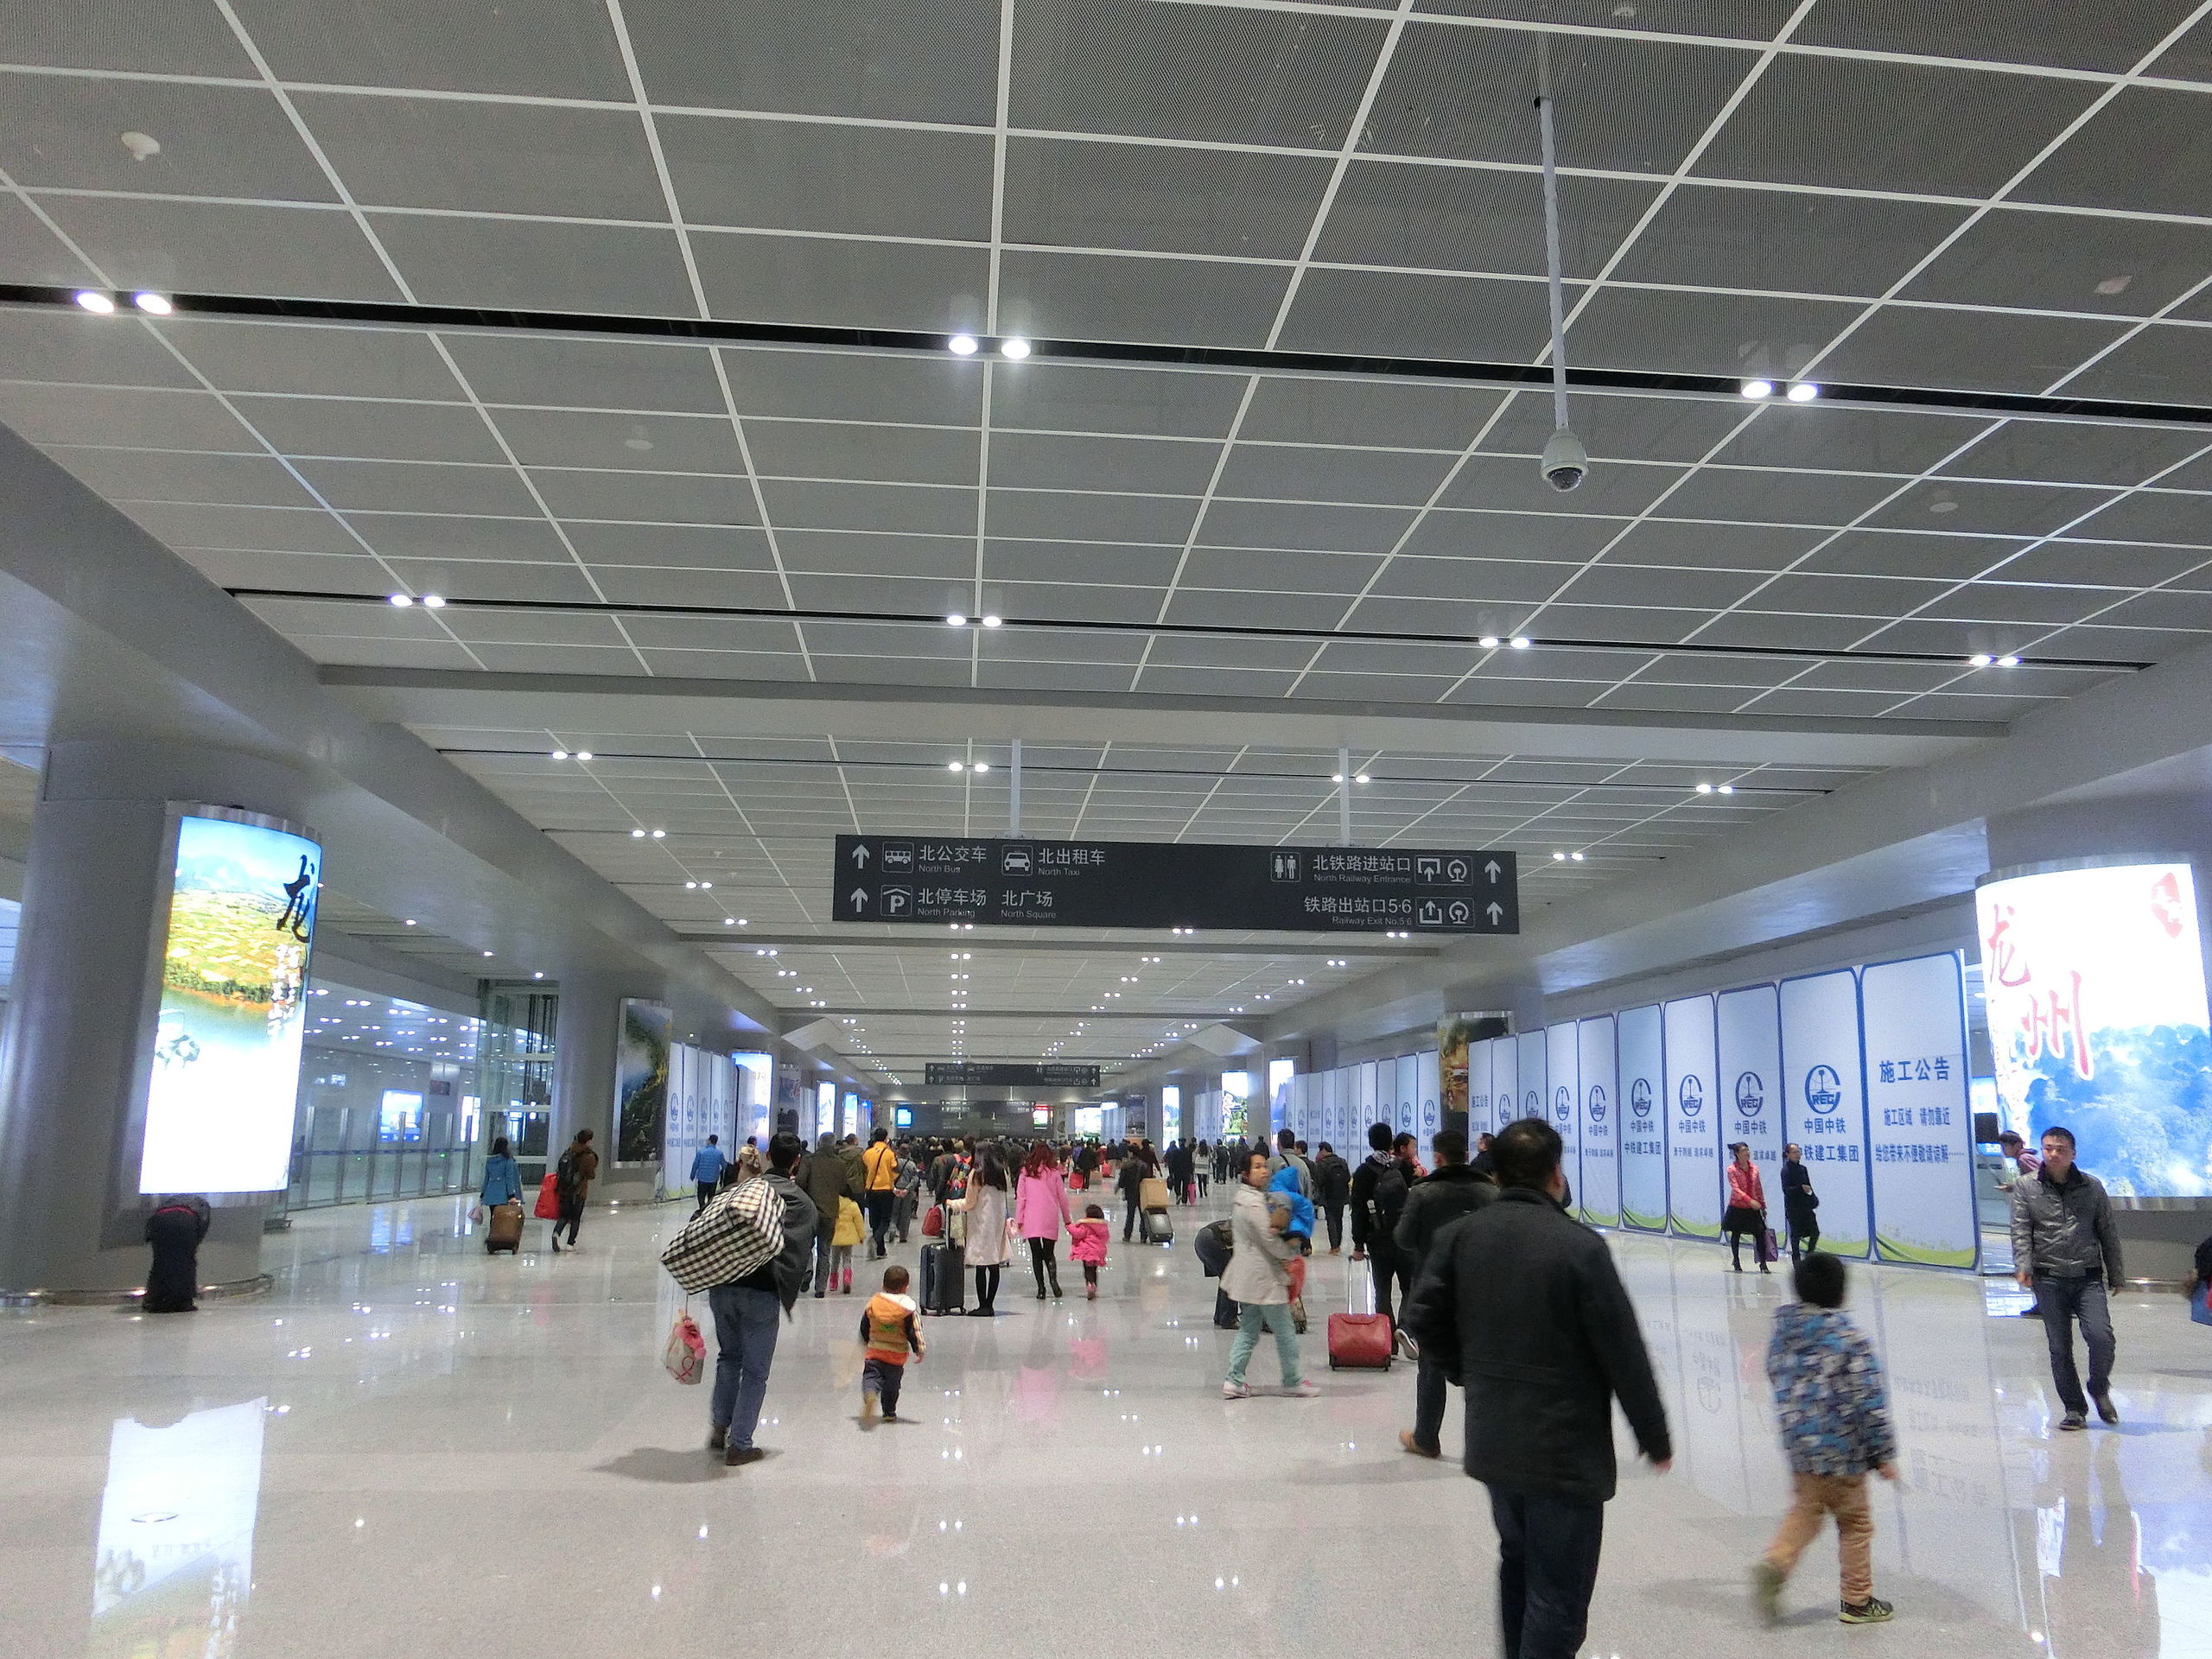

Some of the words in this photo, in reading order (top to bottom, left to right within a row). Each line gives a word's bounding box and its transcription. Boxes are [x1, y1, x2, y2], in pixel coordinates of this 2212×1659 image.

[918, 844, 987, 863] 北公交车
[1039, 848, 1106, 866] 北出租车
[944, 865, 961, 874] Bus
[1313, 855, 1410, 872] 北铁路进站口
[1064, 868, 1080, 876] Taxi
[1338, 874, 1372, 884] Railway
[1374, 874, 1411, 884] Entrance
[918, 887, 987, 906] 北停车场
[1001, 889, 1053, 907] 北广场
[918, 907, 941, 916] North
[943, 908, 976, 918] Parking
[1001, 909, 1024, 918] North
[1027, 910, 1057, 920] Square
[1332, 916, 1365, 926] Railway
[1879, 1056, 1950, 1084] 施工公告
[1678, 1120, 1706, 1134] 中国中铁
[1734, 1120, 1767, 1135] 中国中铁
[1804, 1117, 1846, 1134] 中国中铁
[1798, 1144, 1859, 1162] 铁建工集团
